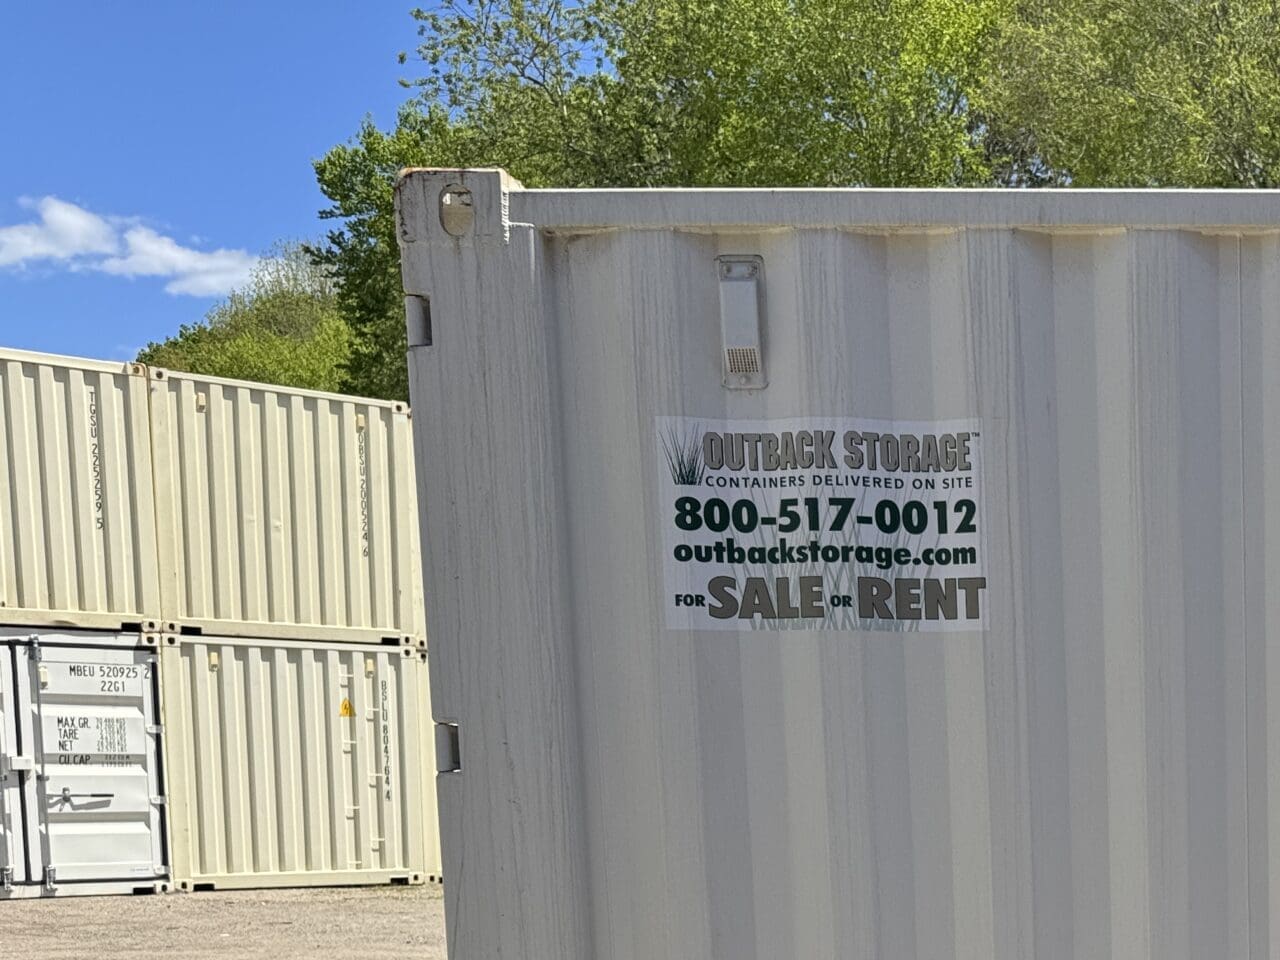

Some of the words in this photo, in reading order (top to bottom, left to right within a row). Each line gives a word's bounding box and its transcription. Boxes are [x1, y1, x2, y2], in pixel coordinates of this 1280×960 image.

[89, 391, 97, 438] TGSU
[703, 431, 837, 471] OUTBACK
[843, 431, 971, 472] STORAGE
[92, 443, 102, 513] 225259
[706, 475, 805, 488] CONTAINERS
[813, 475, 904, 489] DELIVERED
[912, 479, 935, 489] ON
[942, 477, 973, 489] SITE
[97, 518, 104, 530] 5
[674, 497, 976, 534] 800-517-0012
[673, 539, 976, 569] outbackstorage.com
[675, 594, 705, 607] FOR
[708, 576, 824, 619] SALE
[830, 595, 852, 607] OR
[857, 576, 986, 620] RENT
[69, 665, 95, 677] MBEU
[99, 666, 138, 678] 520925
[144, 668, 150, 679] 2
[100, 681, 125, 692] 22G1
[58, 729, 79, 740] TARE
[59, 740, 74, 752] NET
